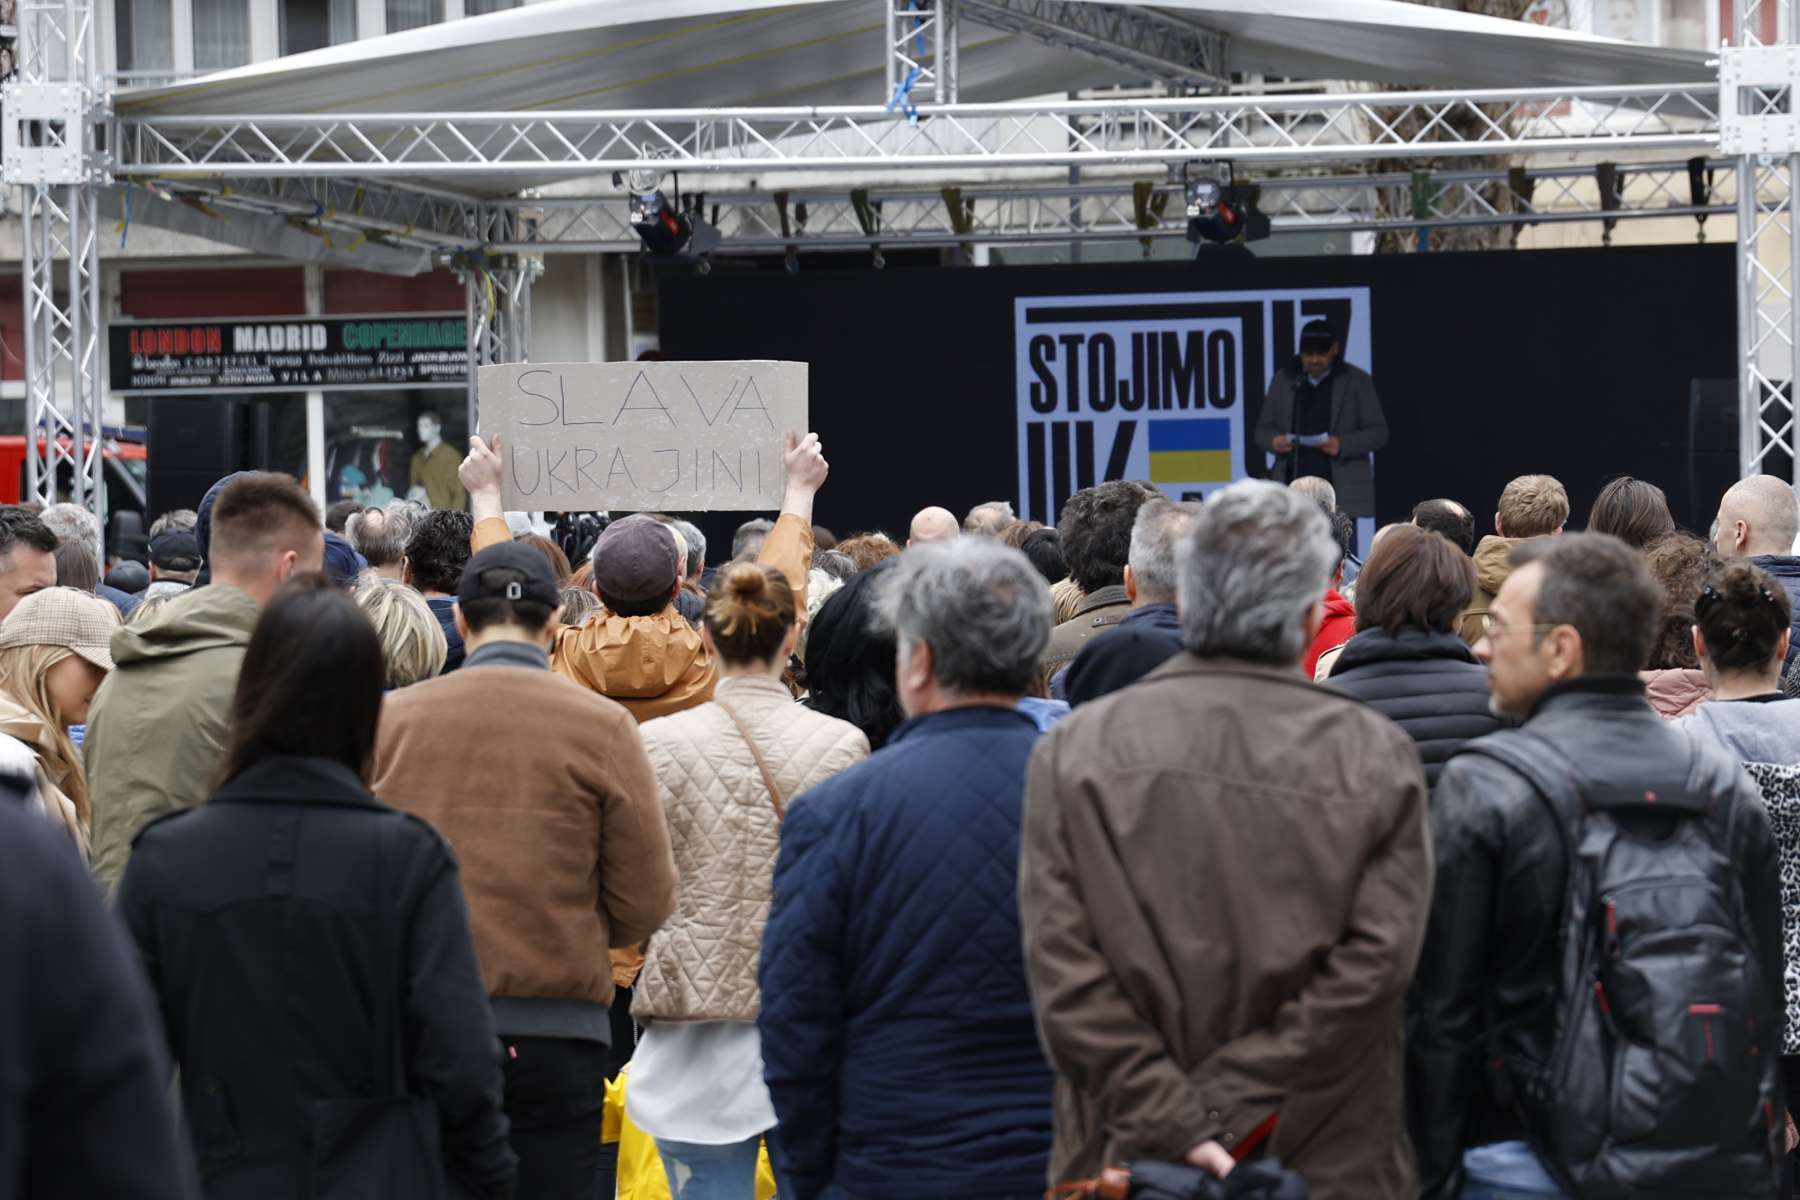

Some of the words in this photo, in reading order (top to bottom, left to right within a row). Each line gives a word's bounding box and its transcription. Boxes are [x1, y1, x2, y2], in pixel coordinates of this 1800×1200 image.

[130, 327, 222, 354] LONDON
[233, 324, 328, 353] MADRID
[342, 319, 468, 350] COPENHAGE
[1029, 328, 1236, 413] STOJIMO
[517, 369, 775, 429] SLAVA
[511, 446, 761, 496] UKRAJINI
